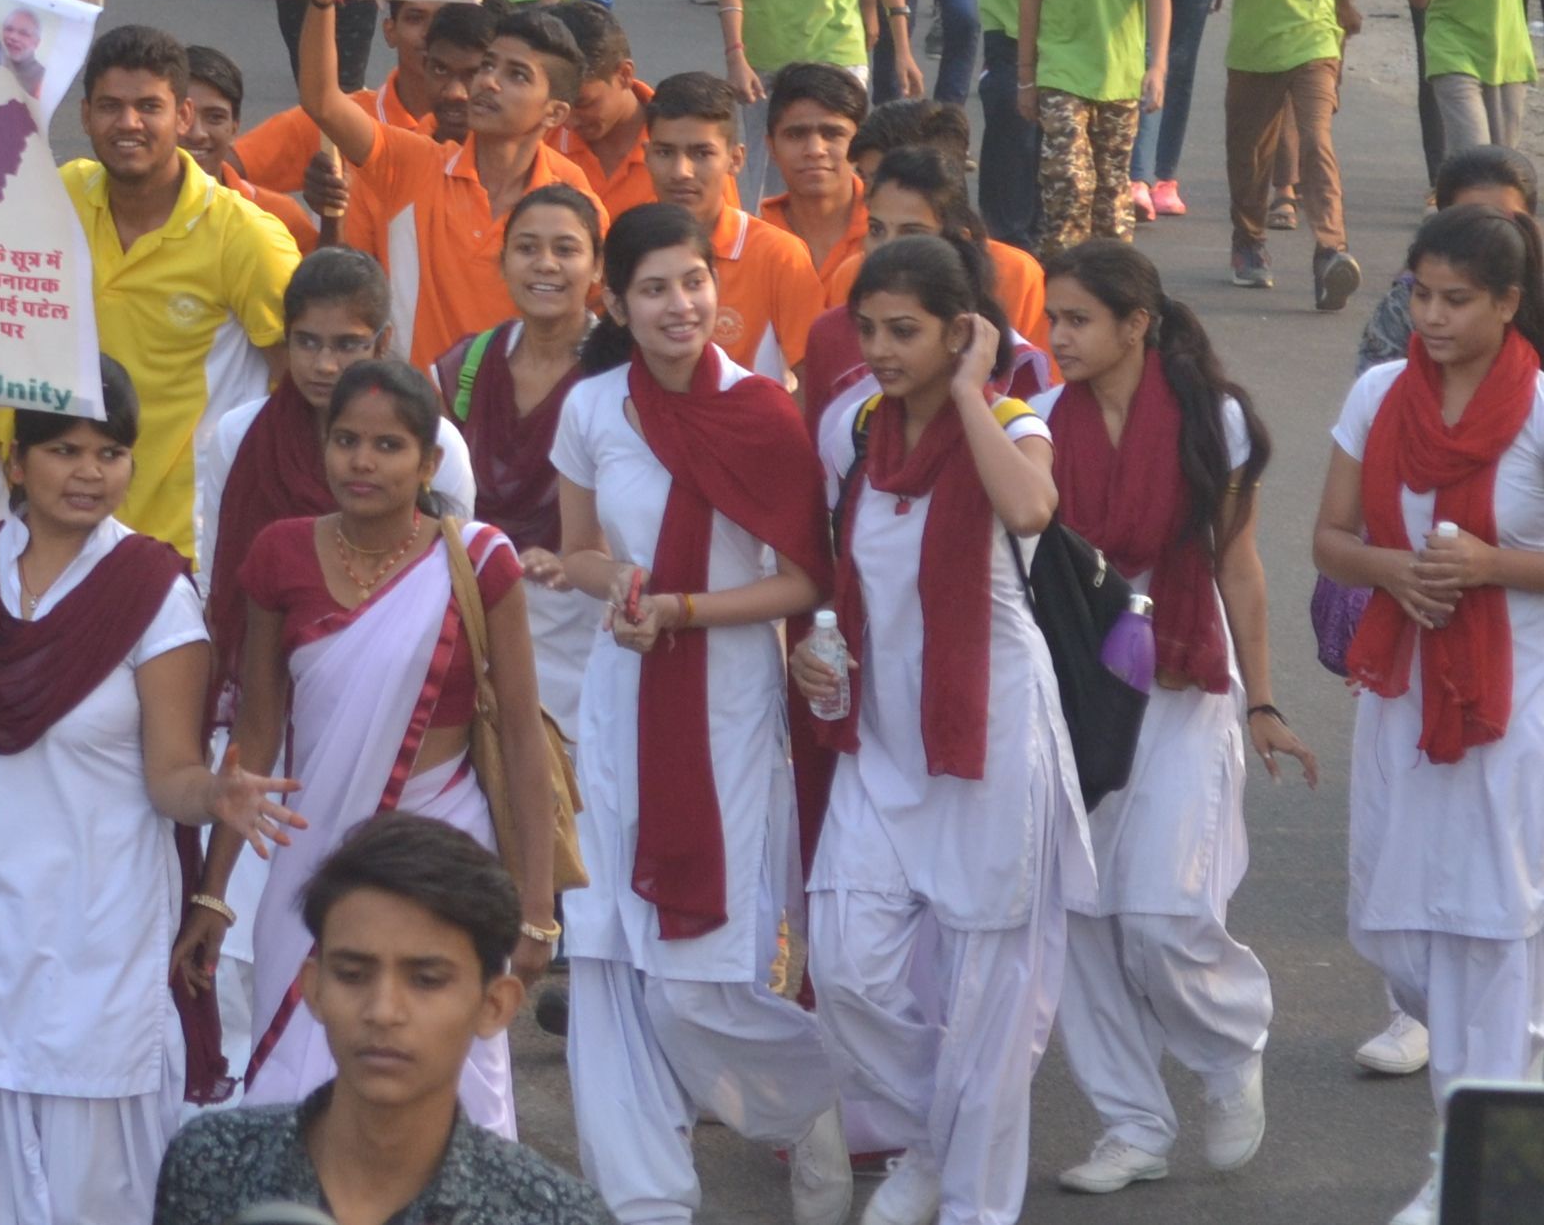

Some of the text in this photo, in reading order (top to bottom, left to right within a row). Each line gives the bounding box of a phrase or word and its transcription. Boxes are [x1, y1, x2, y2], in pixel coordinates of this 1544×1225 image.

[10, 249, 42, 272] सूत्र
[47, 249, 63, 269] में
[22, 298, 70, 320] पटेल
[0, 321, 25, 340] पर
